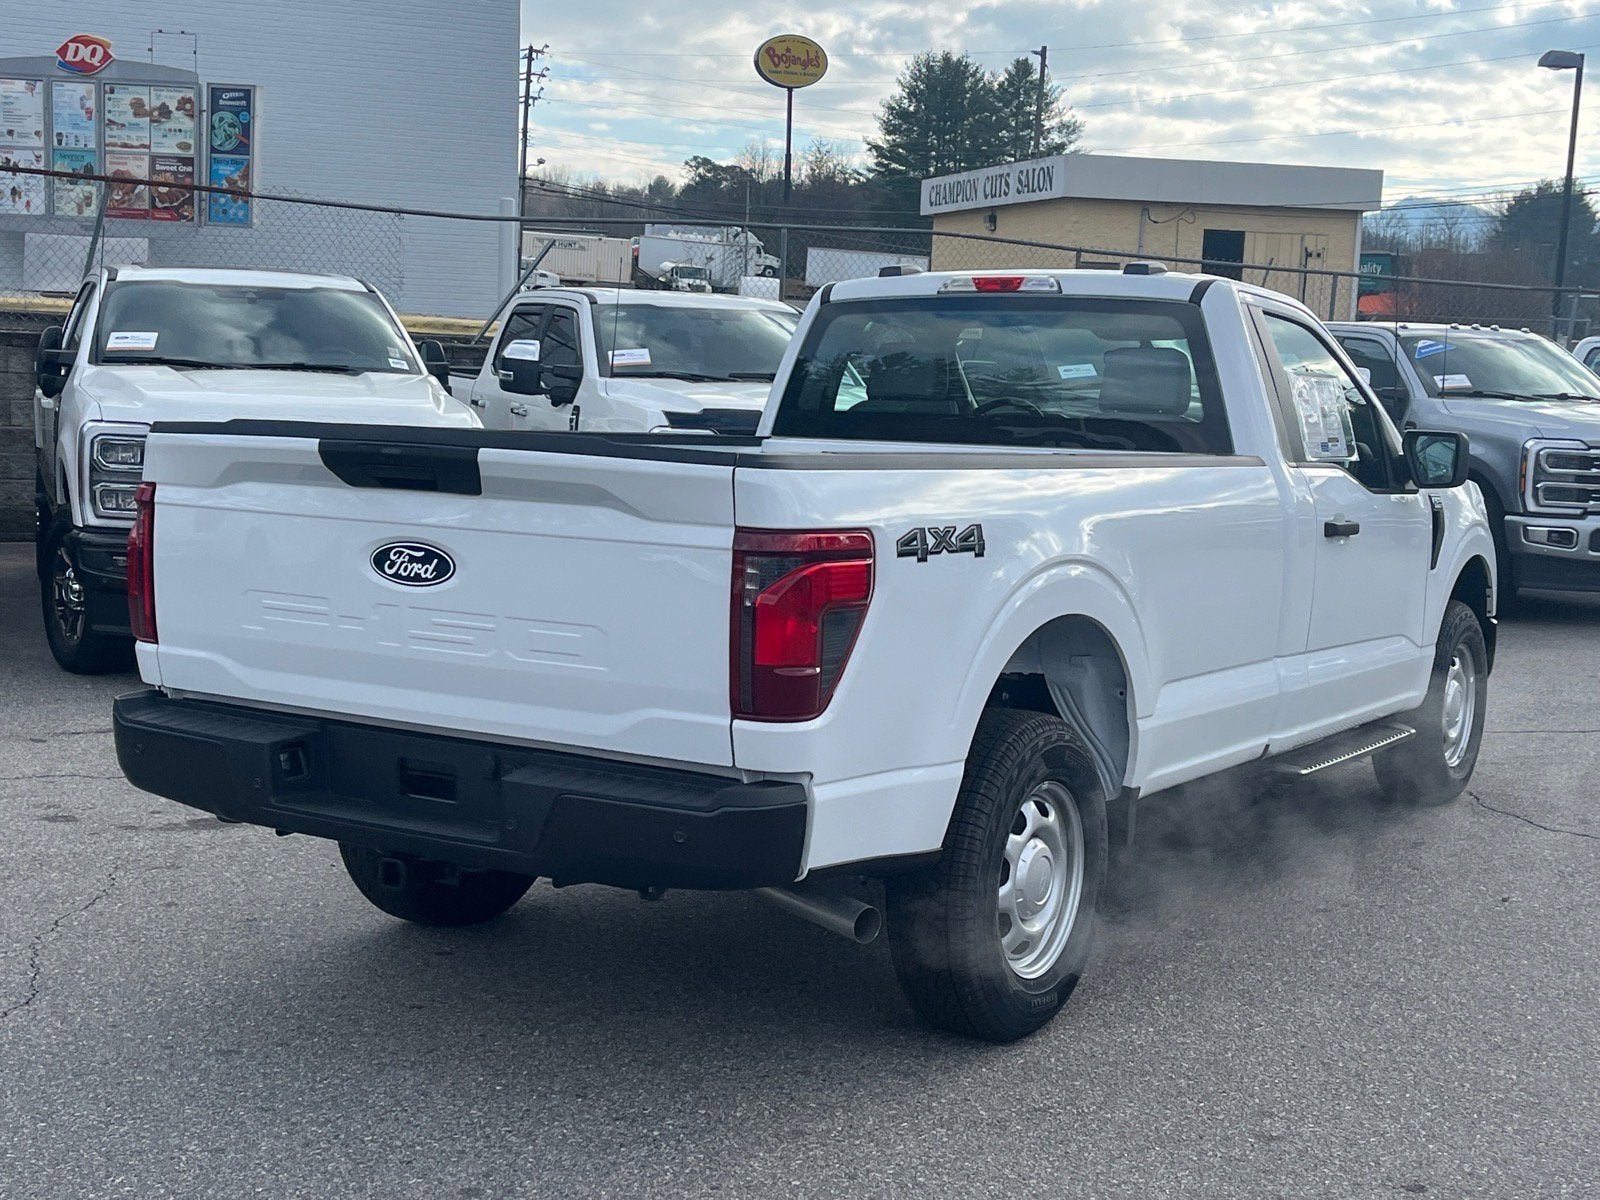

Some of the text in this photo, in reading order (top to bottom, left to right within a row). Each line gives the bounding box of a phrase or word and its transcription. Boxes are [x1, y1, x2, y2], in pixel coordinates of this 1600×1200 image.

[65, 42, 101, 66] DQ
[929, 165, 1055, 207] CHAMPION CUTS SALON
[384, 547, 438, 579] Ford
